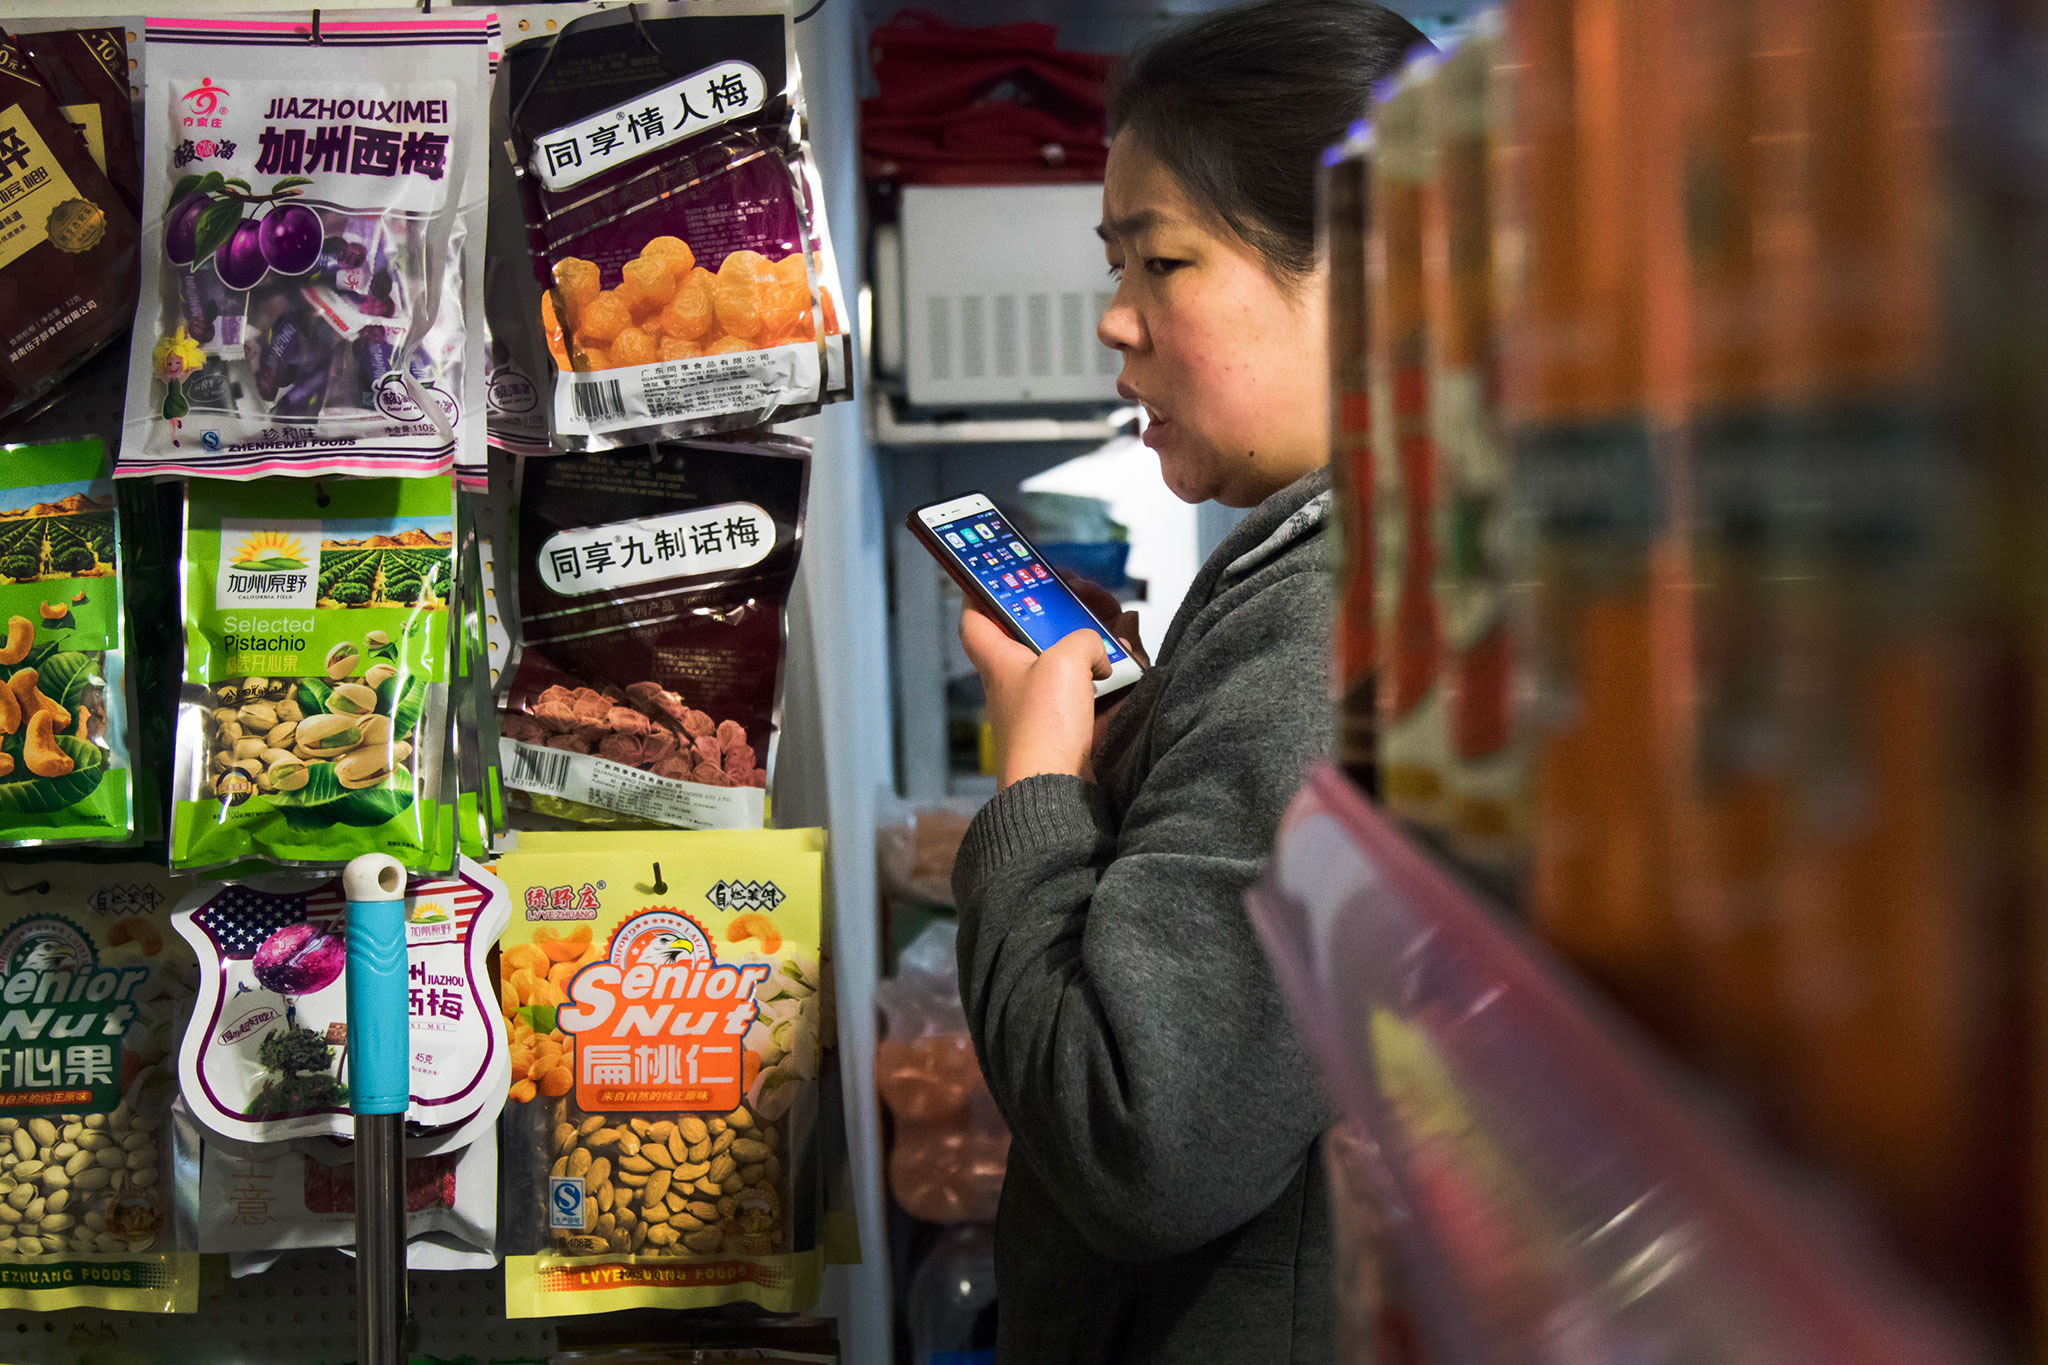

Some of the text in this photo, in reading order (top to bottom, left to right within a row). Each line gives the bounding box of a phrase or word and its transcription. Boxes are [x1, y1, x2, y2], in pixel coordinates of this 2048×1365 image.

[264, 97, 448, 124] JIAZHOUXIMEI
[544, 74, 748, 177] 同享情人梅
[254, 124, 449, 181] 加州西梅
[641, 354, 769, 377] 广东同享食品有限公司
[262, 427, 317, 441] 珍和味
[228, 438, 357, 453] ZHENHEWEI FOODS
[550, 516, 760, 582] 同享九制话梅
[227, 574, 308, 593] 加州原野
[224, 616, 315, 633] Selected
[224, 635, 305, 653] Pistachio
[526, 886, 599, 909] 绿野庄
[527, 909, 596, 920] LVYEZHUANG
[0, 965, 147, 1005] enior
[427, 975, 465, 987] JIAZHOU
[560, 963, 767, 1033] Senior
[0, 1003, 135, 1042] Nut
[611, 1002, 756, 1038] Nut
[415, 1052, 433, 1065] 45克
[583, 1044, 734, 1085] 扁桃仁
[601, 1090, 709, 1102] 来自自然的纯正原味
[82, 1268, 131, 1281] FOODS
[696, 1266, 747, 1281] FOODS
